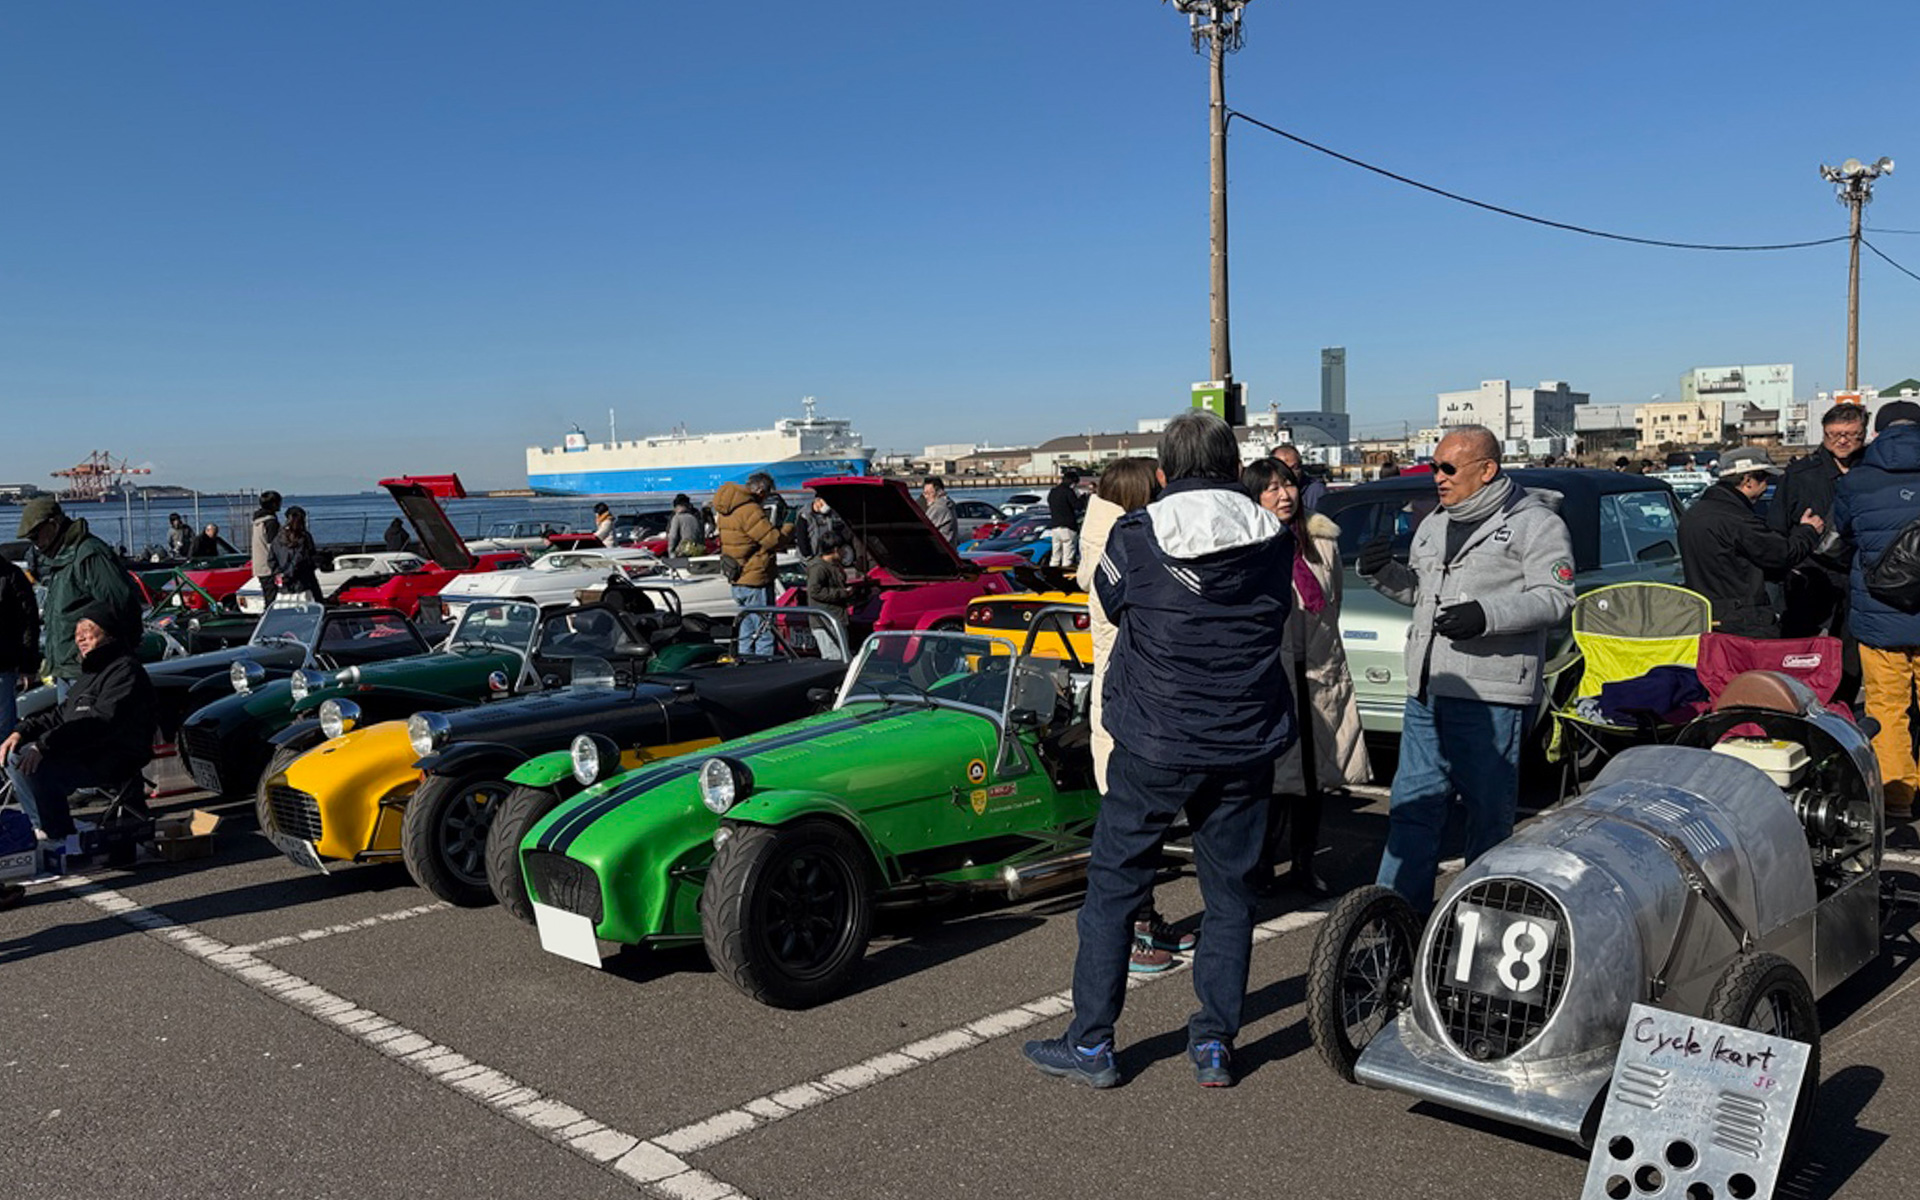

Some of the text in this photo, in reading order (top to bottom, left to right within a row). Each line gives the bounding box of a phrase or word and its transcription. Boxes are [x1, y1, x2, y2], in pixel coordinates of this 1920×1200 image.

[1447, 402, 1474, 411] 山九
[1455, 911, 1549, 992] 18
[1634, 1016, 1702, 1057] Cycle
[1753, 1076, 1777, 1090] JP
